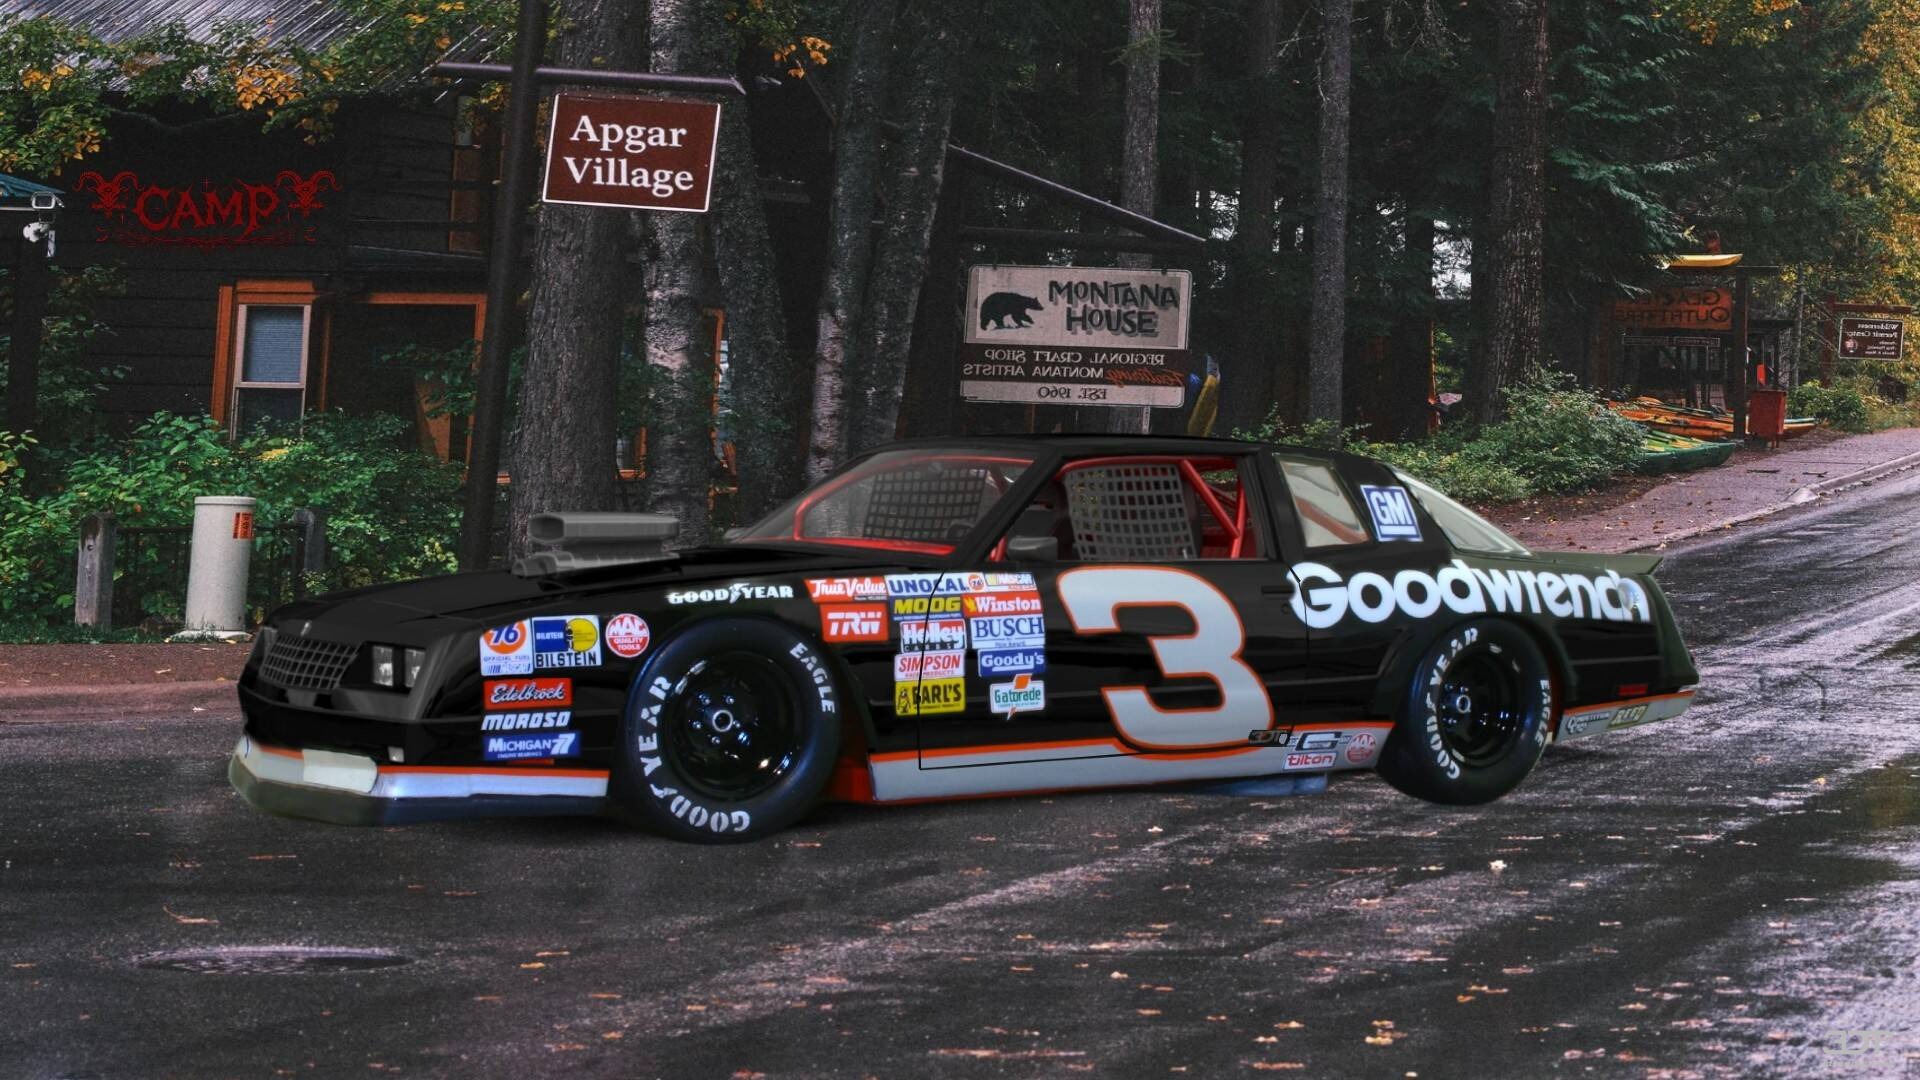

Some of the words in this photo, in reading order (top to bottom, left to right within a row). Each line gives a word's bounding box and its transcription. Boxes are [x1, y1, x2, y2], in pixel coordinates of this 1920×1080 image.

[569, 115, 687, 153] Apgar
[563, 156, 694, 197] Village
[132, 178, 281, 239] CAMP
[1049, 280, 1179, 310] MONTANA
[1066, 304, 1157, 334] HOUSE
[1369, 490, 1413, 525] GM
[975, 595, 1042, 613] Winston
[1286, 558, 1650, 629] Goodwrench
[894, 597, 962, 614] MOOG
[490, 623, 519, 645] 76
[611, 614, 648, 637] MAC
[827, 611, 882, 637] TRW
[973, 617, 1045, 638] BUSCH
[617, 643, 641, 651] TOOLS
[903, 622, 963, 650] Holley
[536, 651, 597, 668] BILSTEIN
[899, 655, 960, 673] SIMPSON
[981, 651, 1044, 672] Goody's
[1055, 564, 1275, 750] 3
[789, 642, 836, 715] EAGLE
[490, 682, 565, 704] Edelbrock
[912, 683, 962, 705] EARL'S
[994, 686, 1041, 704] Gatorade
[481, 711, 571, 731] MOROSO
[1534, 679, 1551, 747] EAGLE
[488, 736, 552, 752] MICHIGAN
[550, 733, 576, 755] 77
[1287, 754, 1333, 767] tilton
